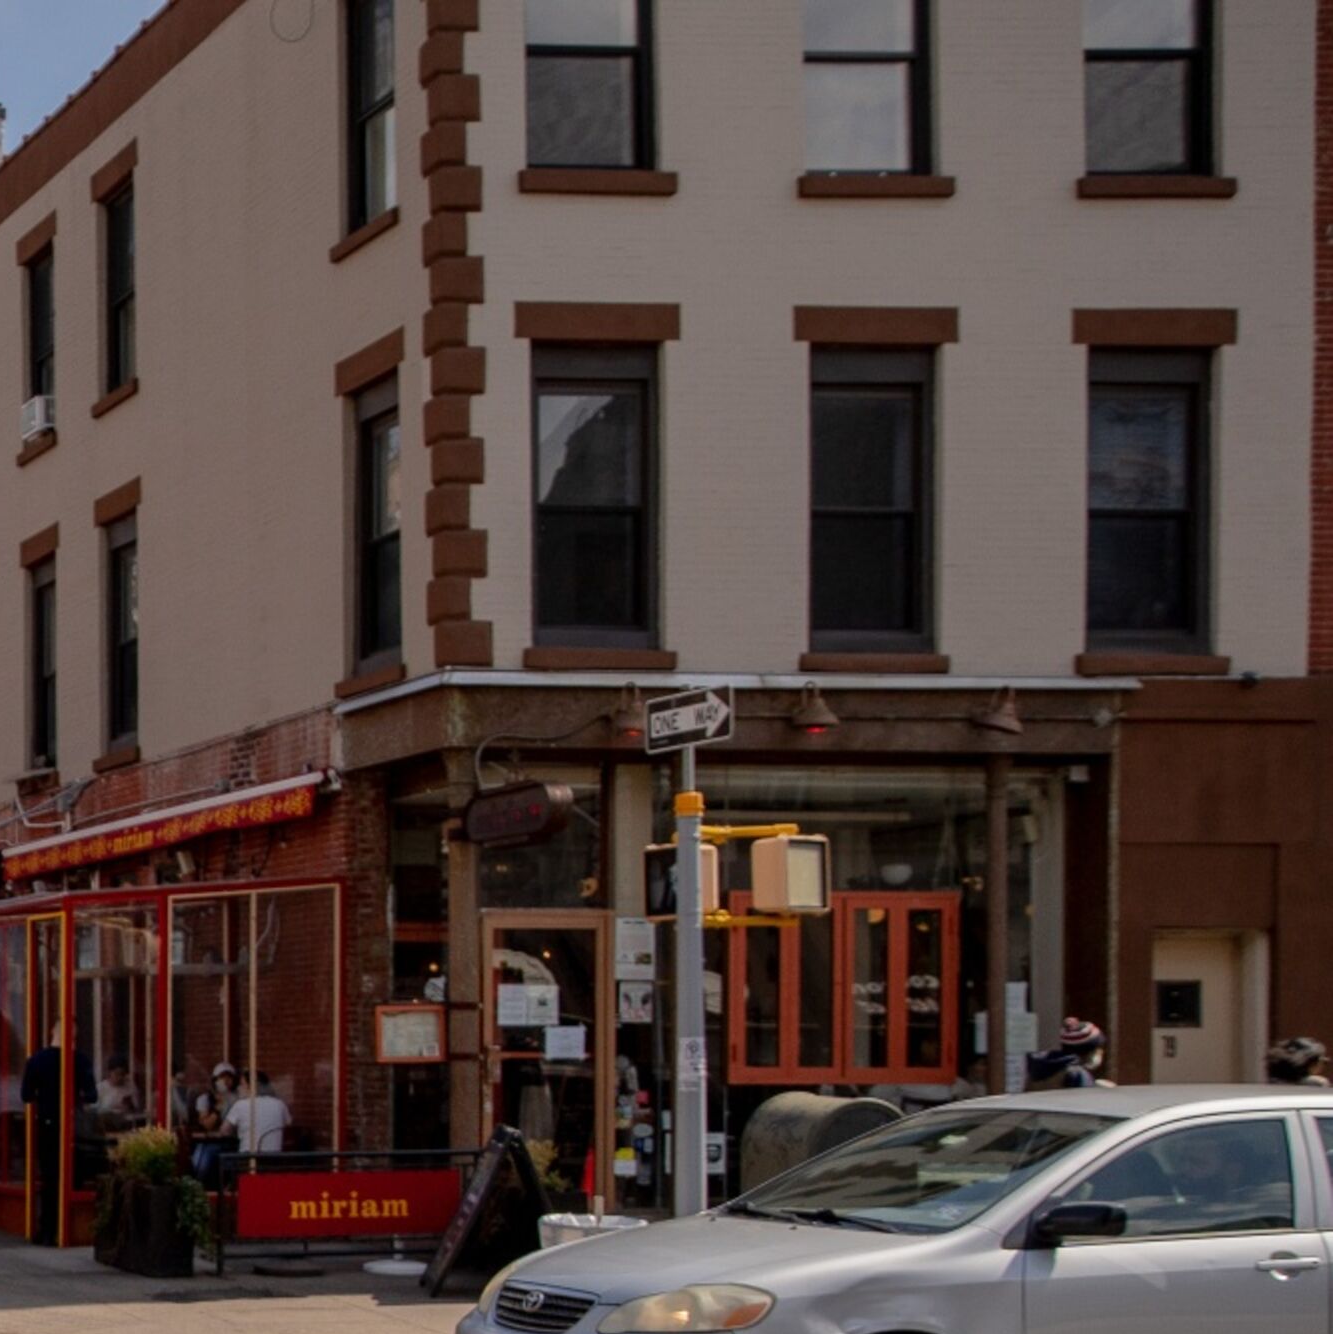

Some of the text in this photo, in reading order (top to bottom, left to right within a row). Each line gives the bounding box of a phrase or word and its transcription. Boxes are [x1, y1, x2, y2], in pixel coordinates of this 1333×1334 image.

[653, 703, 720, 734] ONE WAY
[289, 1190, 409, 1219] miriam
